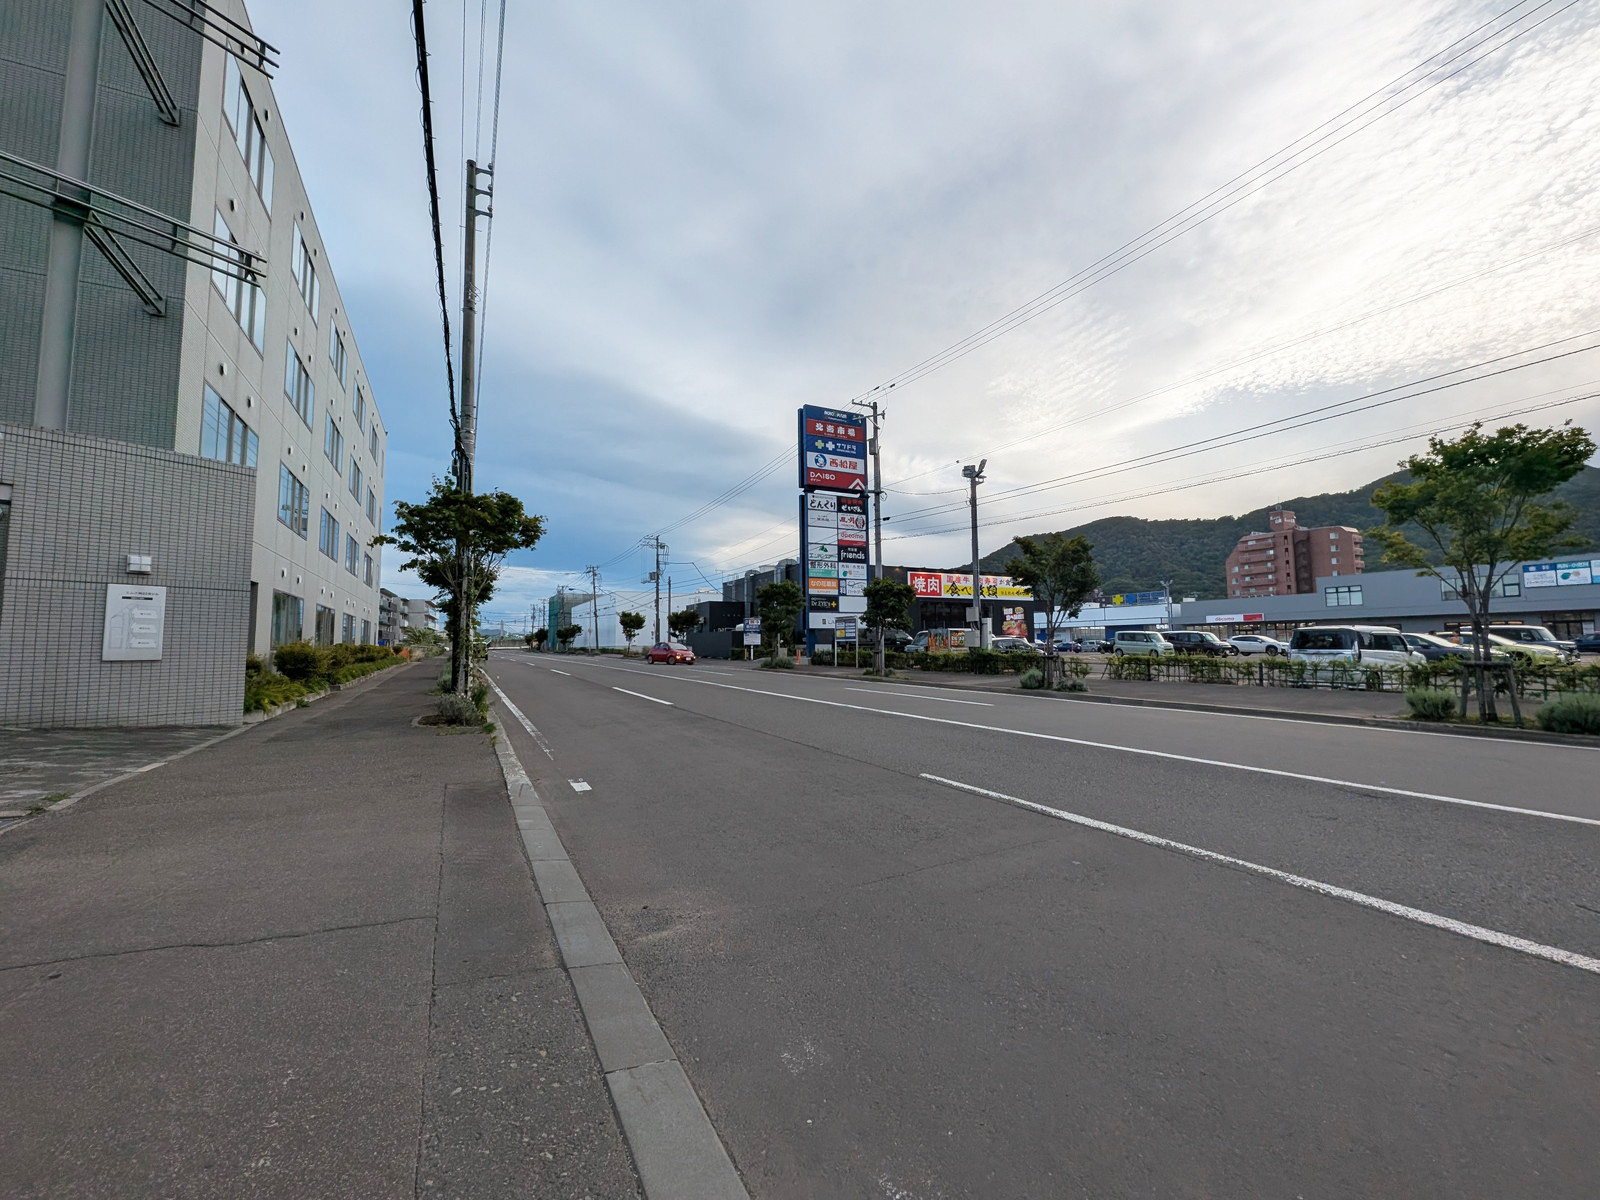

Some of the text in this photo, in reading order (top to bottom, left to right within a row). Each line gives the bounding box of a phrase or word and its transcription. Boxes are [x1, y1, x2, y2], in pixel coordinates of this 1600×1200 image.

[829, 457, 858, 471] 西松屋
[809, 471, 836, 481] DAISO
[840, 549, 865, 561] friends
[809, 561, 837, 570] 整形外科
[913, 575, 940, 593] 焼肉
